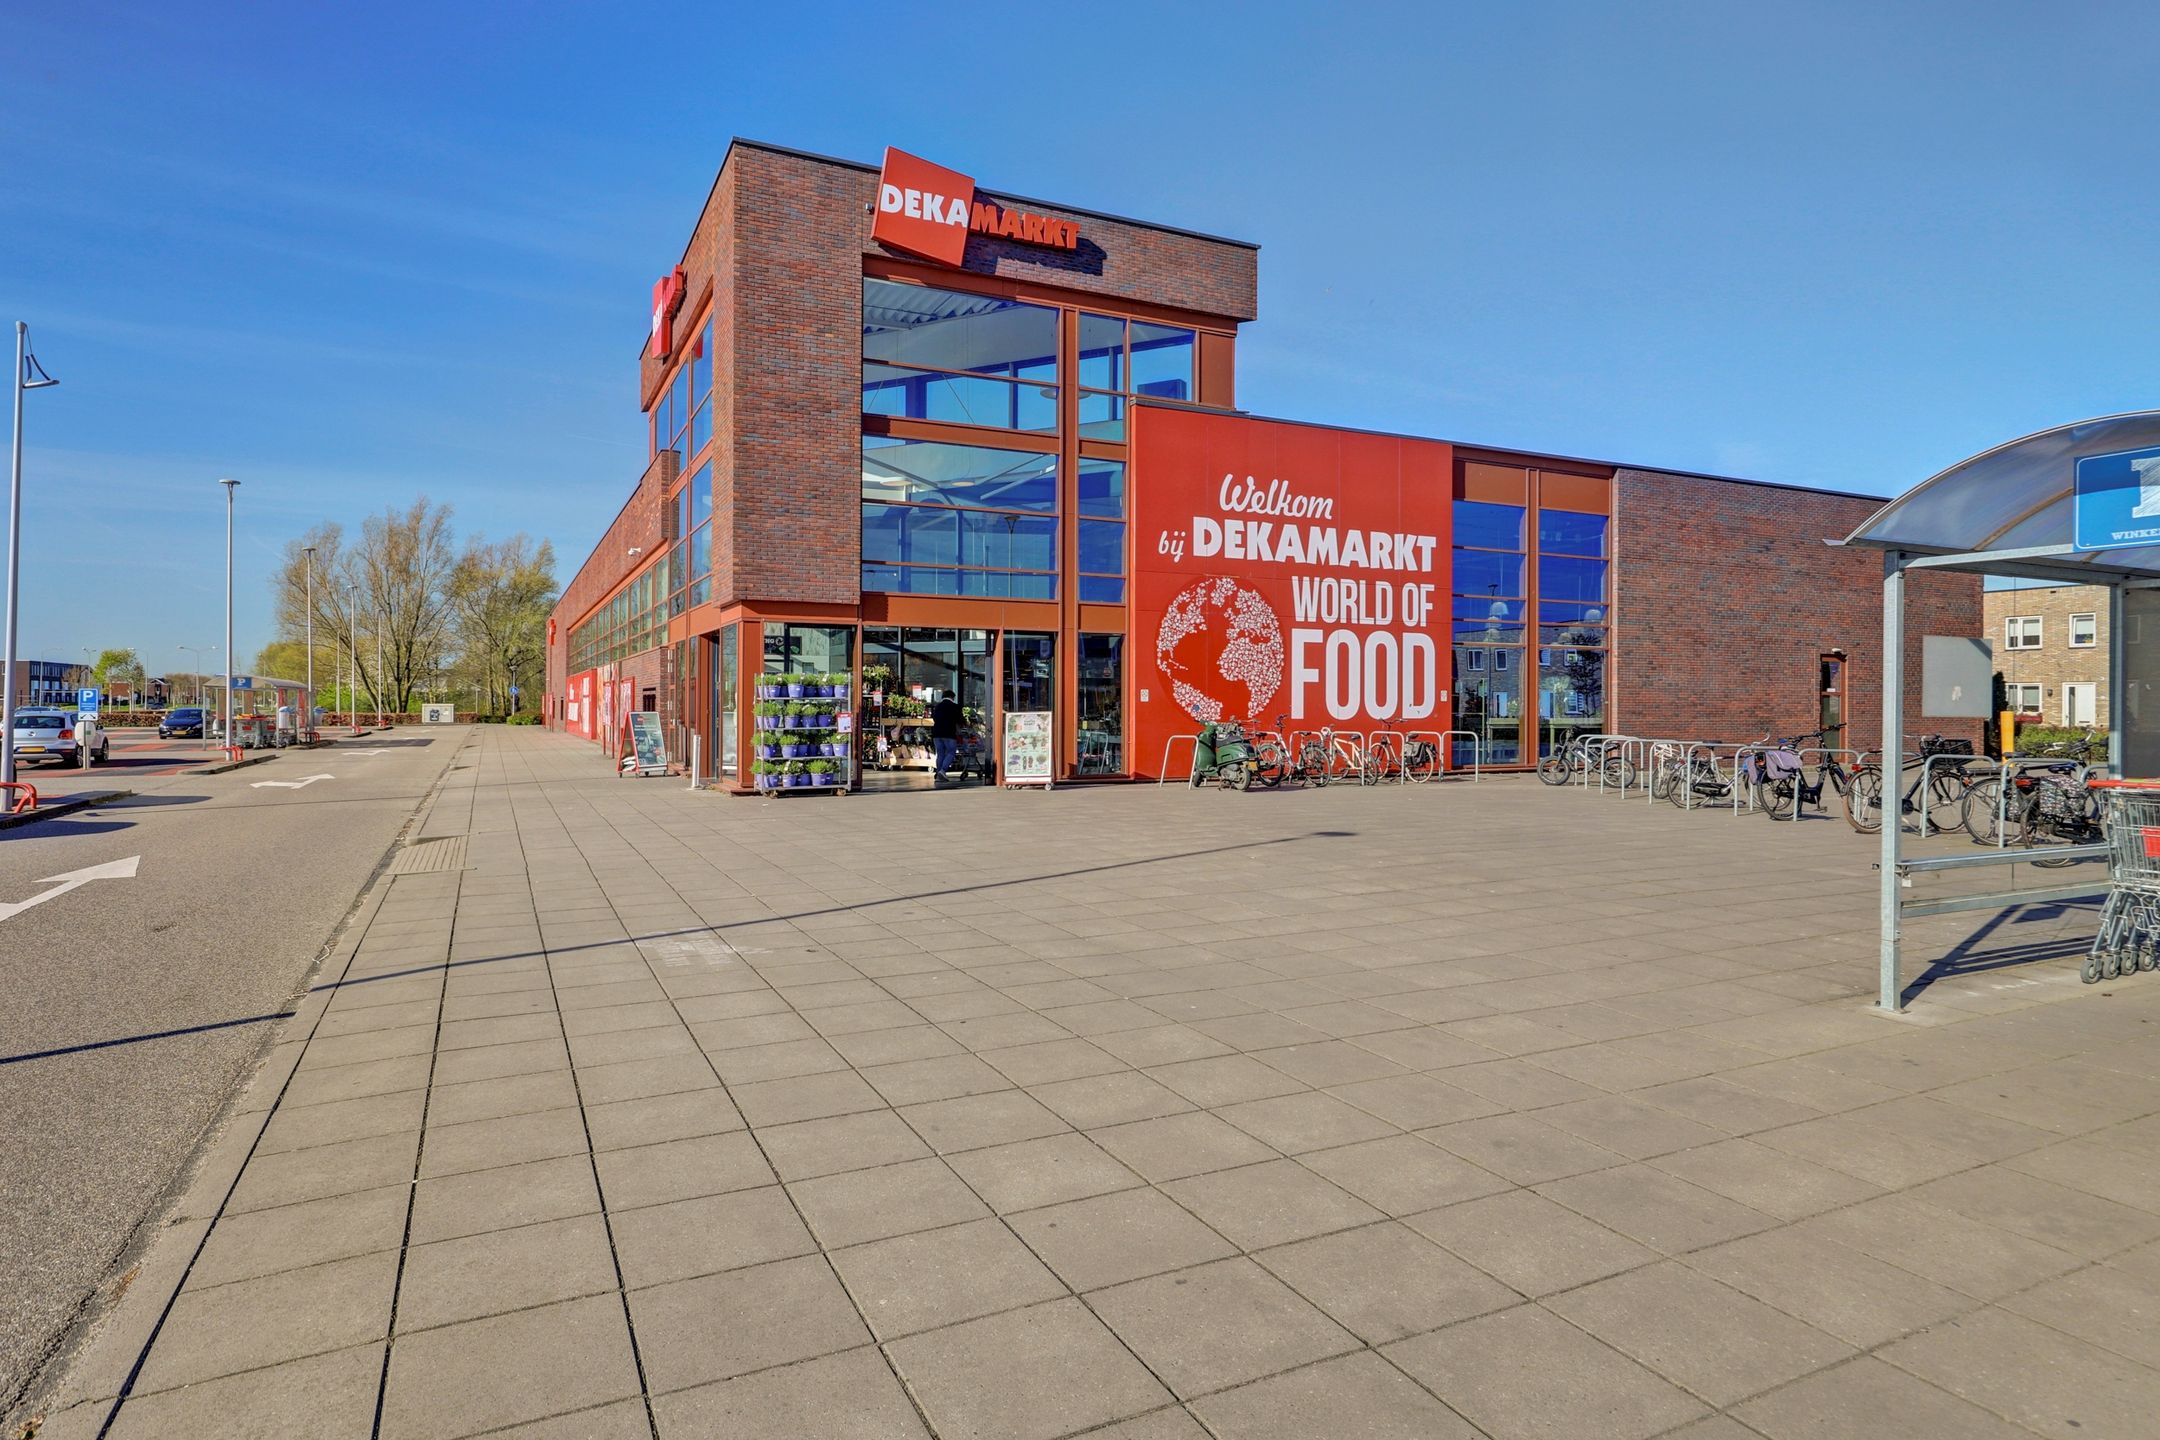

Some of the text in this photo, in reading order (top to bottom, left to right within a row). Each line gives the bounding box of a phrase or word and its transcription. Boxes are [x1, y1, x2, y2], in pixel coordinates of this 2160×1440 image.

[1219, 473, 1334, 520] Welkom
[1158, 516, 1437, 573] bij DEKAMARKT
[2111, 528, 2160, 540] WINKE
[1291, 575, 1436, 628] WORLD OF
[83, 690, 93, 701] P
[1290, 628, 1437, 721] FOOD
